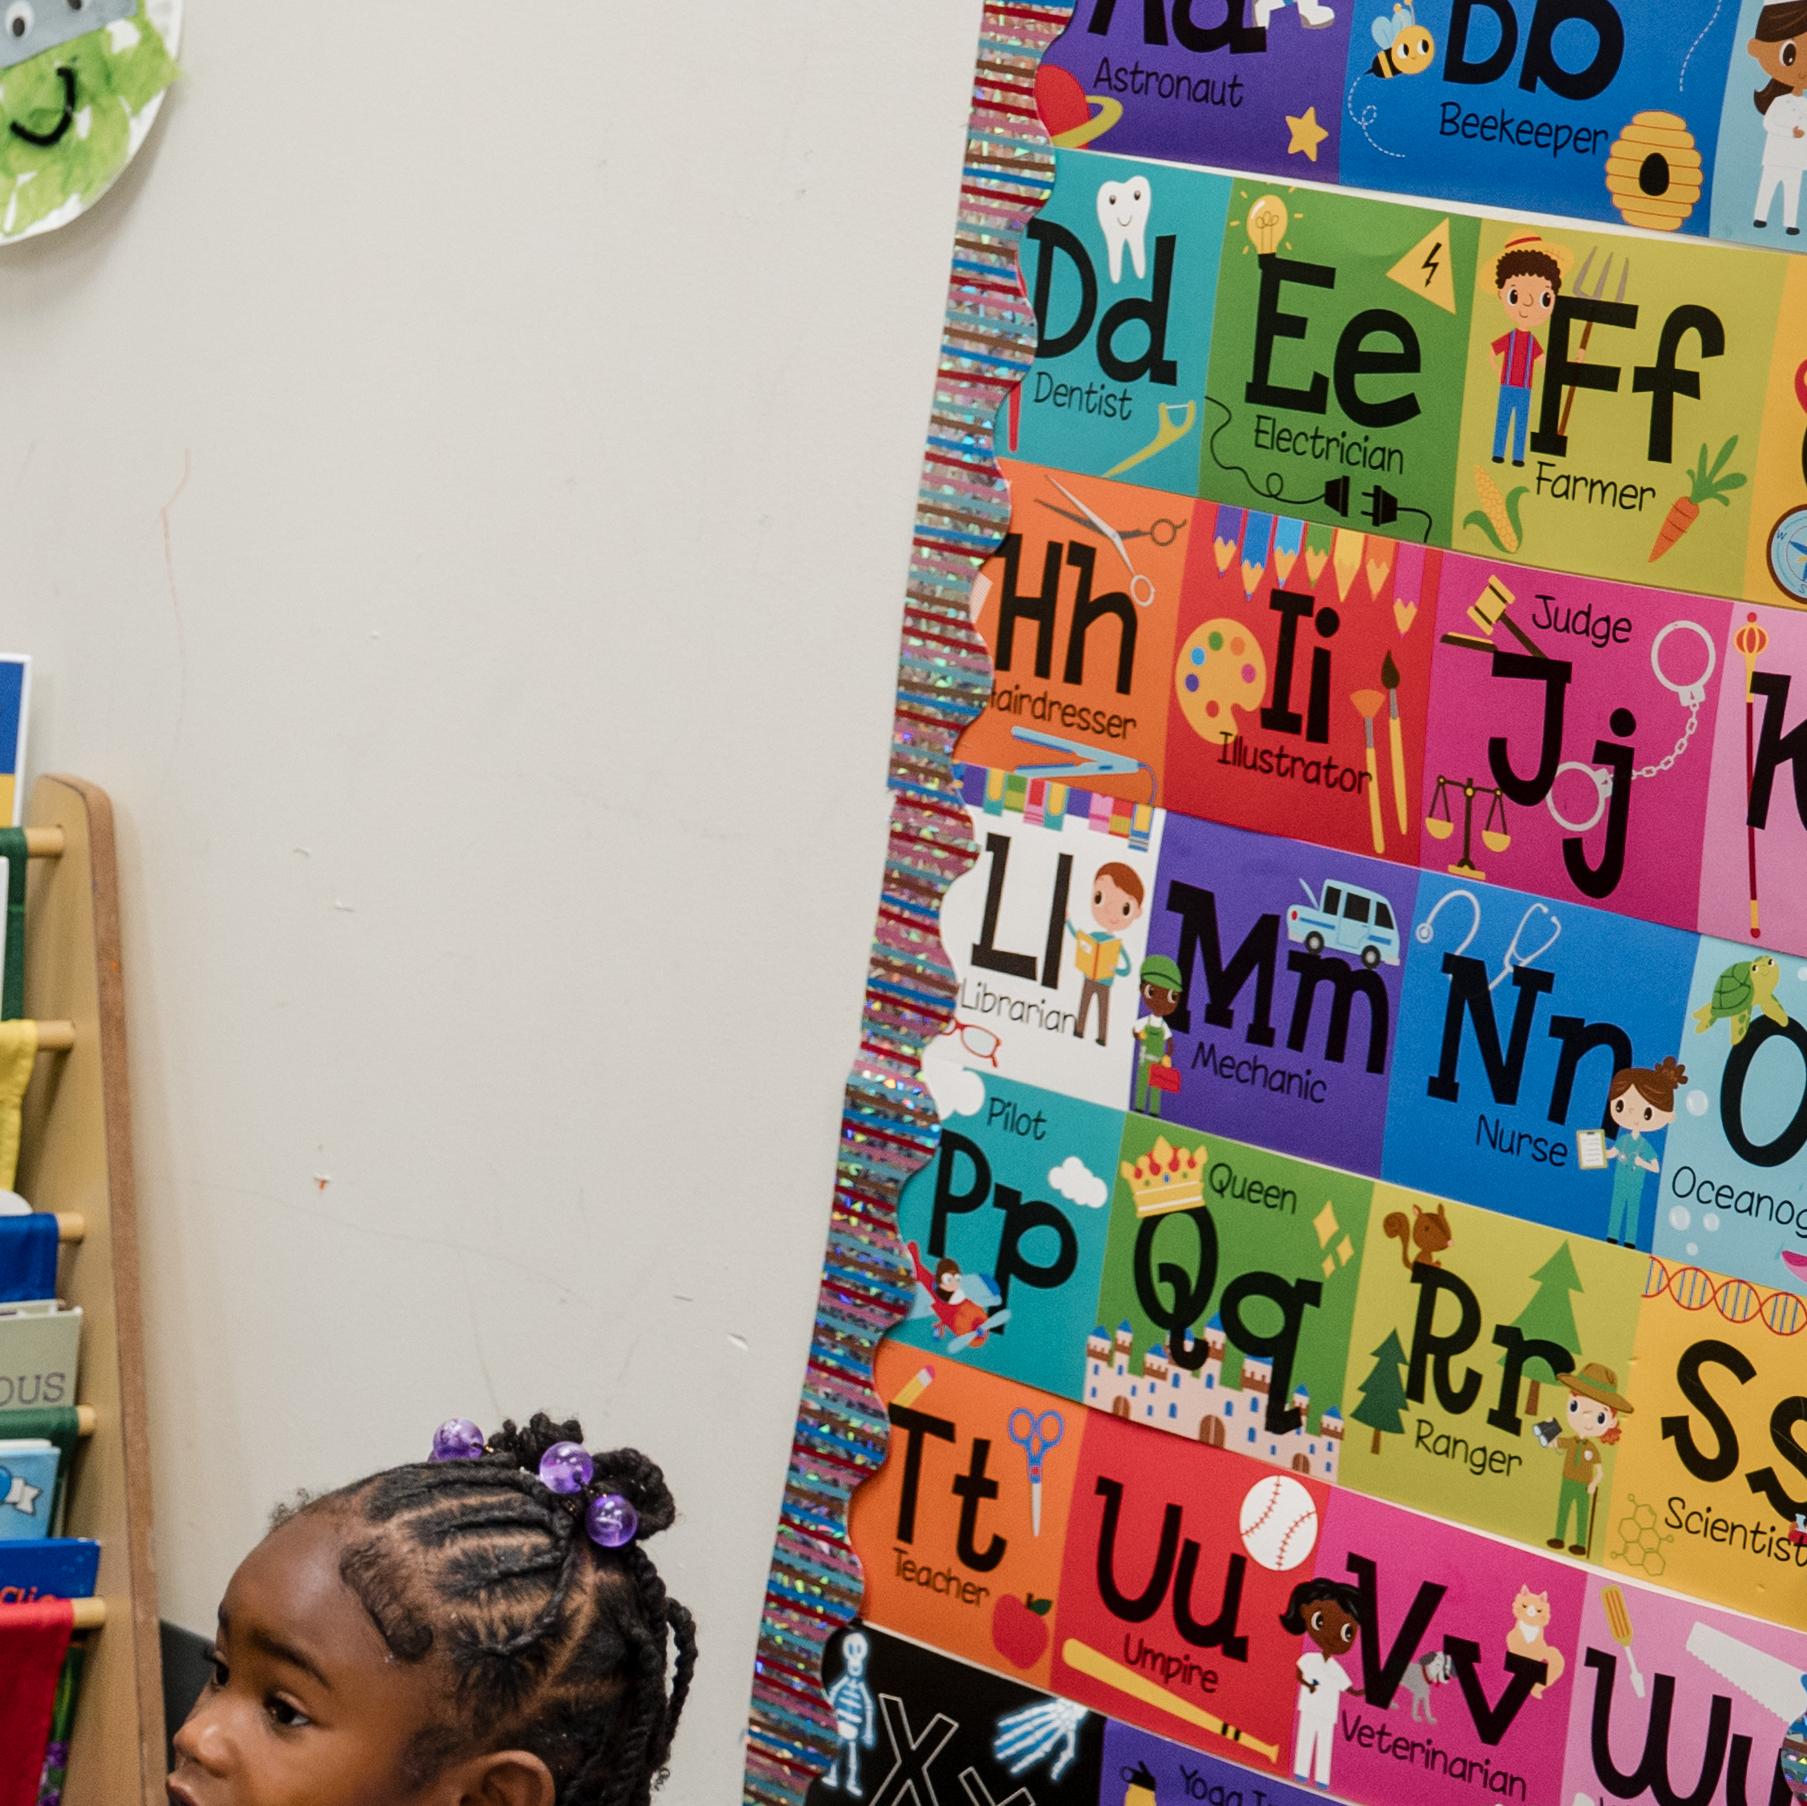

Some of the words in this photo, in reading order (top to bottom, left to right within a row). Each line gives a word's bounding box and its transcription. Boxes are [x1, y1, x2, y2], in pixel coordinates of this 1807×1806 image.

[1093, 57, 1244, 109] Astronaut
[1443, 0, 1624, 100] Bb
[1439, 102, 1608, 157] Beekeeper
[1025, 219, 1178, 386] Dd
[1245, 254, 1423, 428] Ee
[1034, 371, 1132, 421] Dentist
[1530, 295, 1725, 463] Ff
[1255, 417, 1404, 475] Electrician
[1536, 461, 1656, 513] Farmer
[992, 533, 1138, 696] Hh
[1531, 594, 1633, 644] Judge
[1261, 587, 1341, 744] Ii
[1217, 730, 1373, 795] Illustrator
[1487, 649, 1637, 899] Jj
[971, 834, 1073, 990] Ll
[959, 978, 1080, 1039] Librarian
[1165, 880, 1388, 1075] Mm
[1191, 1042, 1327, 1105] Mechanic
[1427, 953, 1634, 1140] Nn
[988, 1095, 1047, 1142] Pilot
[1476, 1115, 1568, 1166] Nurse
[1208, 1162, 1297, 1214] Queen
[928, 1131, 1080, 1336] Pp
[1133, 1203, 1322, 1436] Qq
[1406, 1262, 1577, 1436] Rr
[890, 1404, 1007, 1572] Tt
[1414, 1419, 1523, 1478] Ranger
[1095, 1477, 1249, 1662] Uu
[1665, 1497, 1807, 1568] Scientist
[894, 1549, 990, 1608] Teacher
[1123, 1634, 1219, 1693] Umpire
[1346, 1553, 1547, 1746] Vv
[1341, 1712, 1527, 1802] Veterinarian
